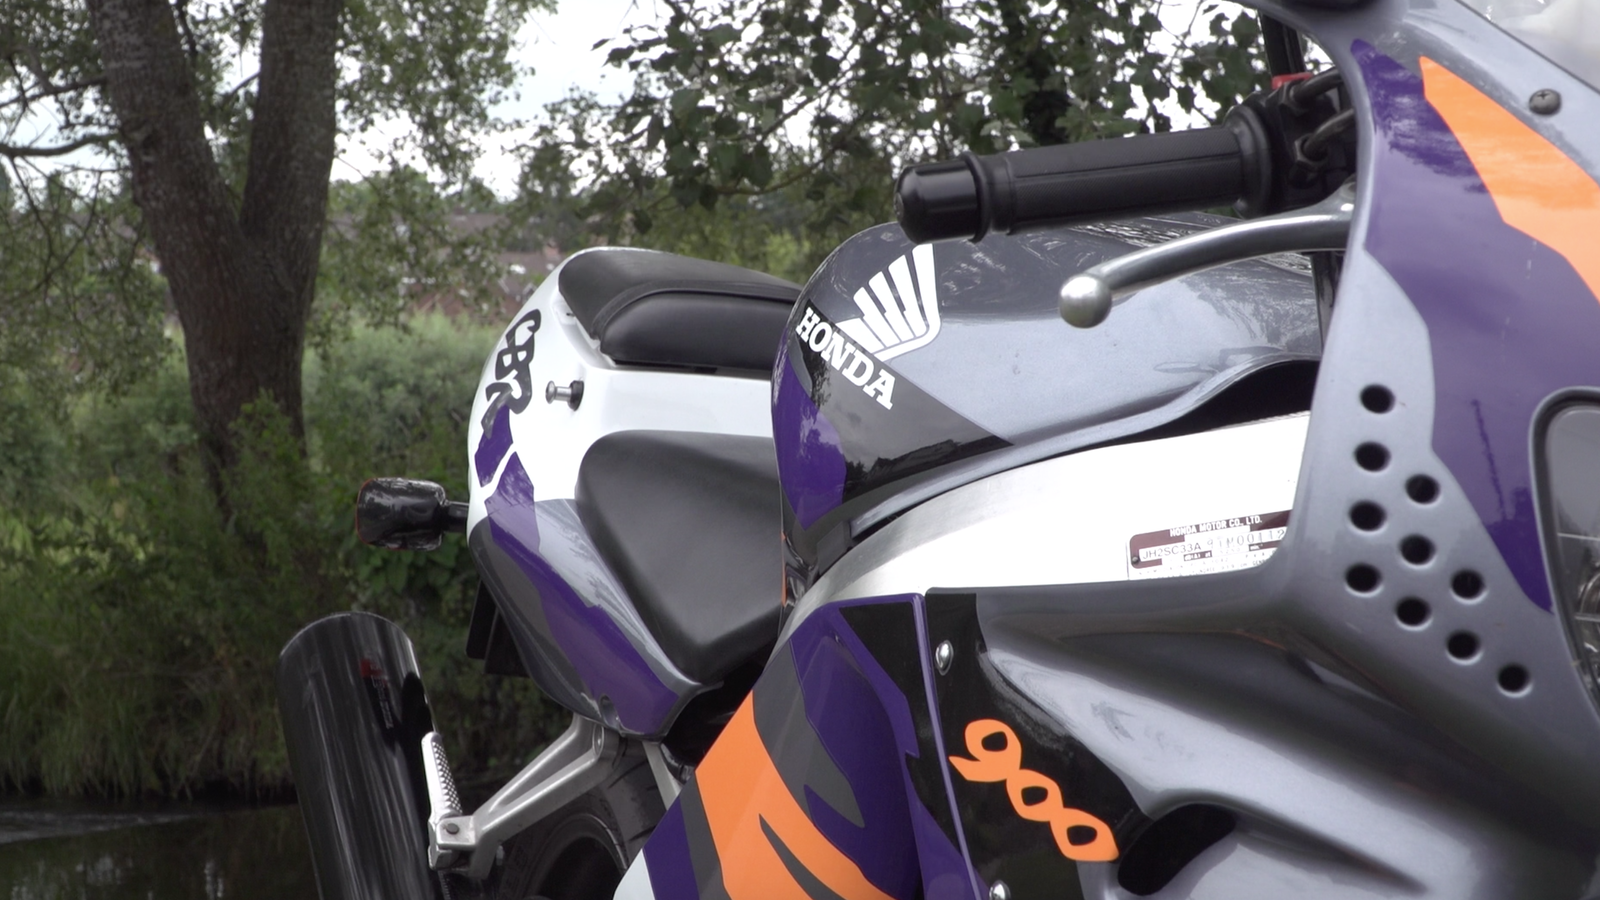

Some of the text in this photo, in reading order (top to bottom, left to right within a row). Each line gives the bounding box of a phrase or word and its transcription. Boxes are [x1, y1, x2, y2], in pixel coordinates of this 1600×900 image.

[481, 309, 541, 439] CBR
[795, 306, 896, 410] HONDA
[1169, 524, 1197, 537] HONDA
[1200, 520, 1227, 532] MOTOR
[1246, 515, 1262, 525] LTD.
[949, 718, 1119, 862] 900
